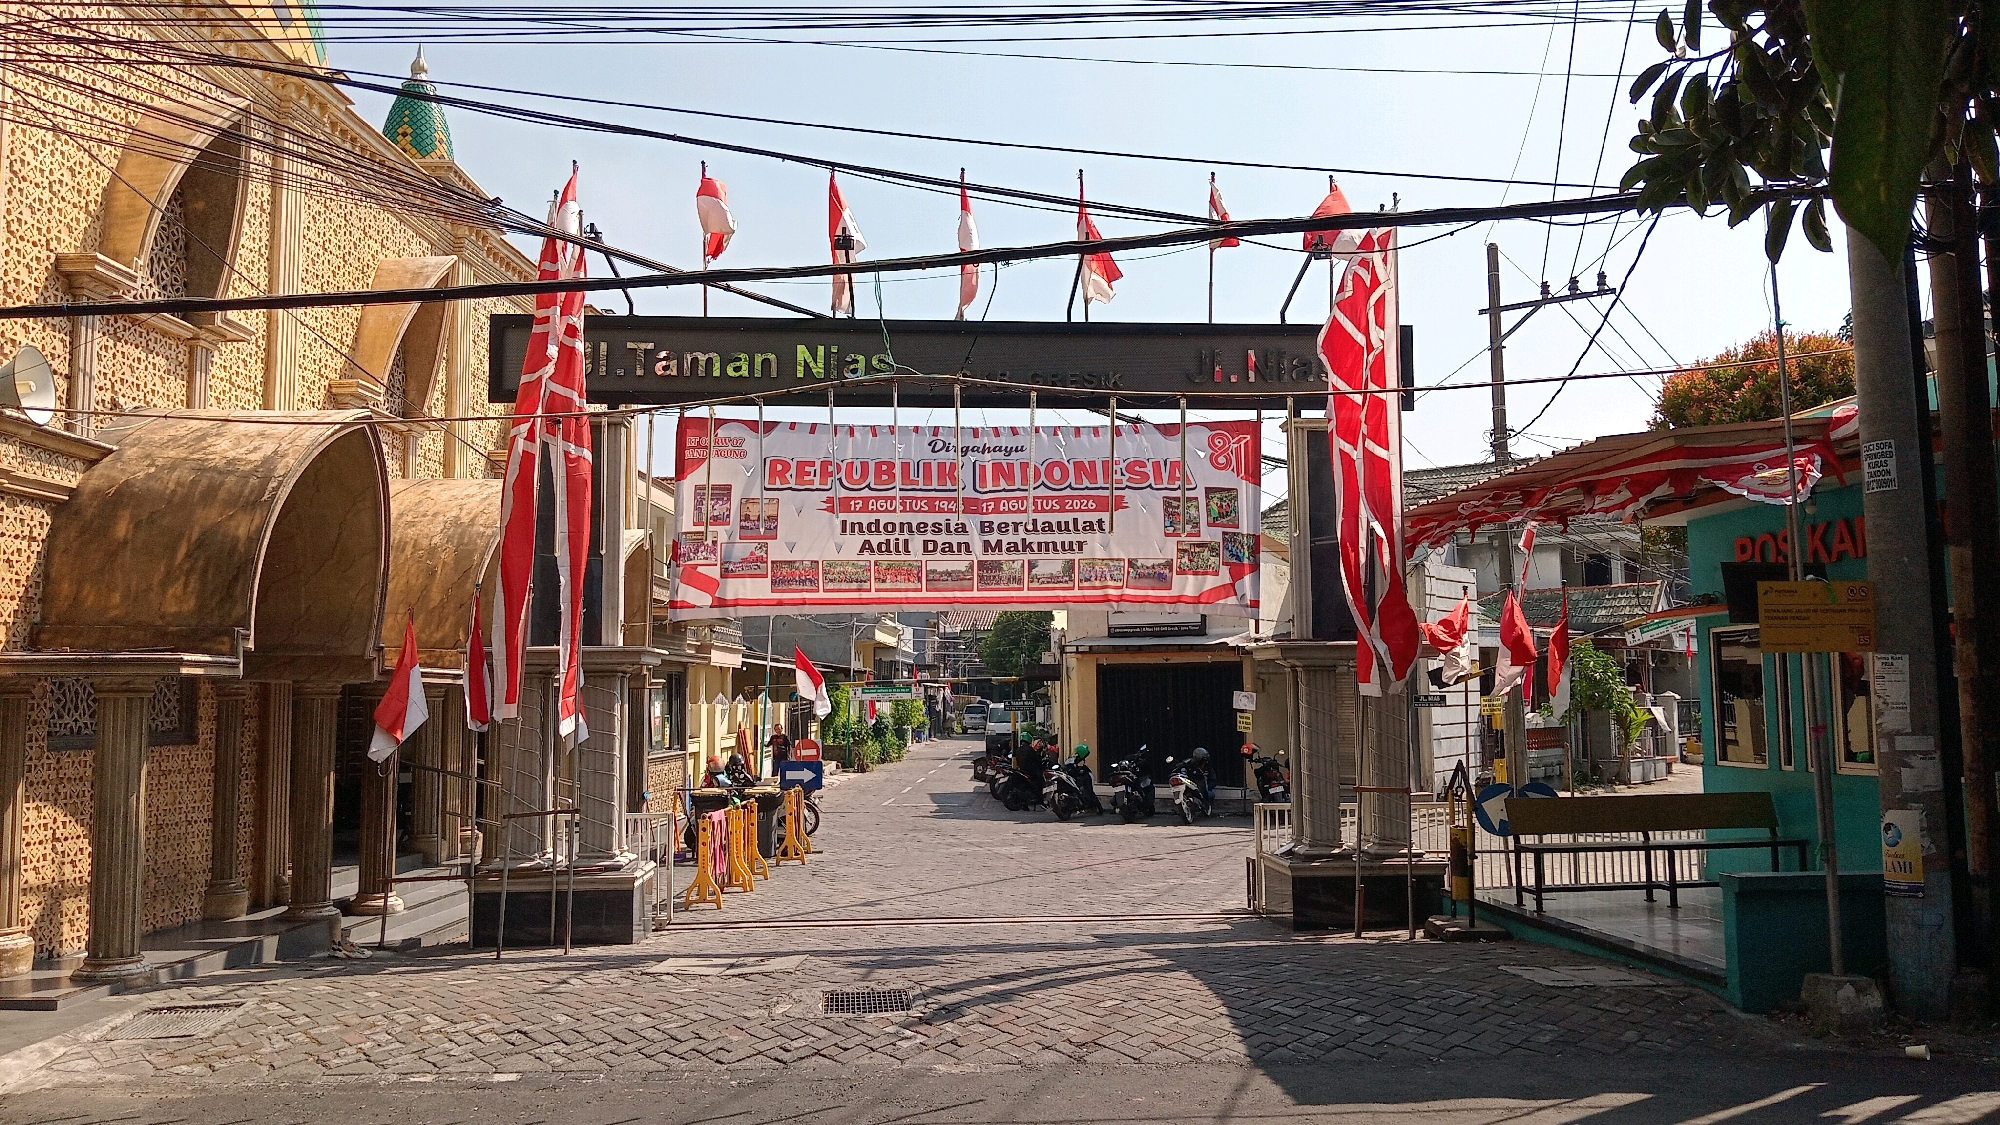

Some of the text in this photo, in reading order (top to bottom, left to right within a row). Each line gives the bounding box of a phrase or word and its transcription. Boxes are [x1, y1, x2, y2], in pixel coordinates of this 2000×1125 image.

[795, 344, 894, 379] Nias
[731, 437, 746, 447] 07
[928, 438, 1028, 460] Dirgahayu
[1875, 441, 1893, 451] SOFA
[1207, 430, 1251, 478] 81
[1867, 459, 1889, 469] KURAS
[766, 458, 1196, 489] REPUBLIK INDONESIA
[1866, 468, 1892, 479] TANDON
[850, 499, 863, 511] 17
[982, 501, 995, 513] 17
[999, 499, 1060, 511] AGUTUS
[1065, 499, 1097, 510] 2026
[840, 517, 1106, 536] Indonesia Berdaulat
[857, 537, 1088, 555] Adil Dan Makmur
